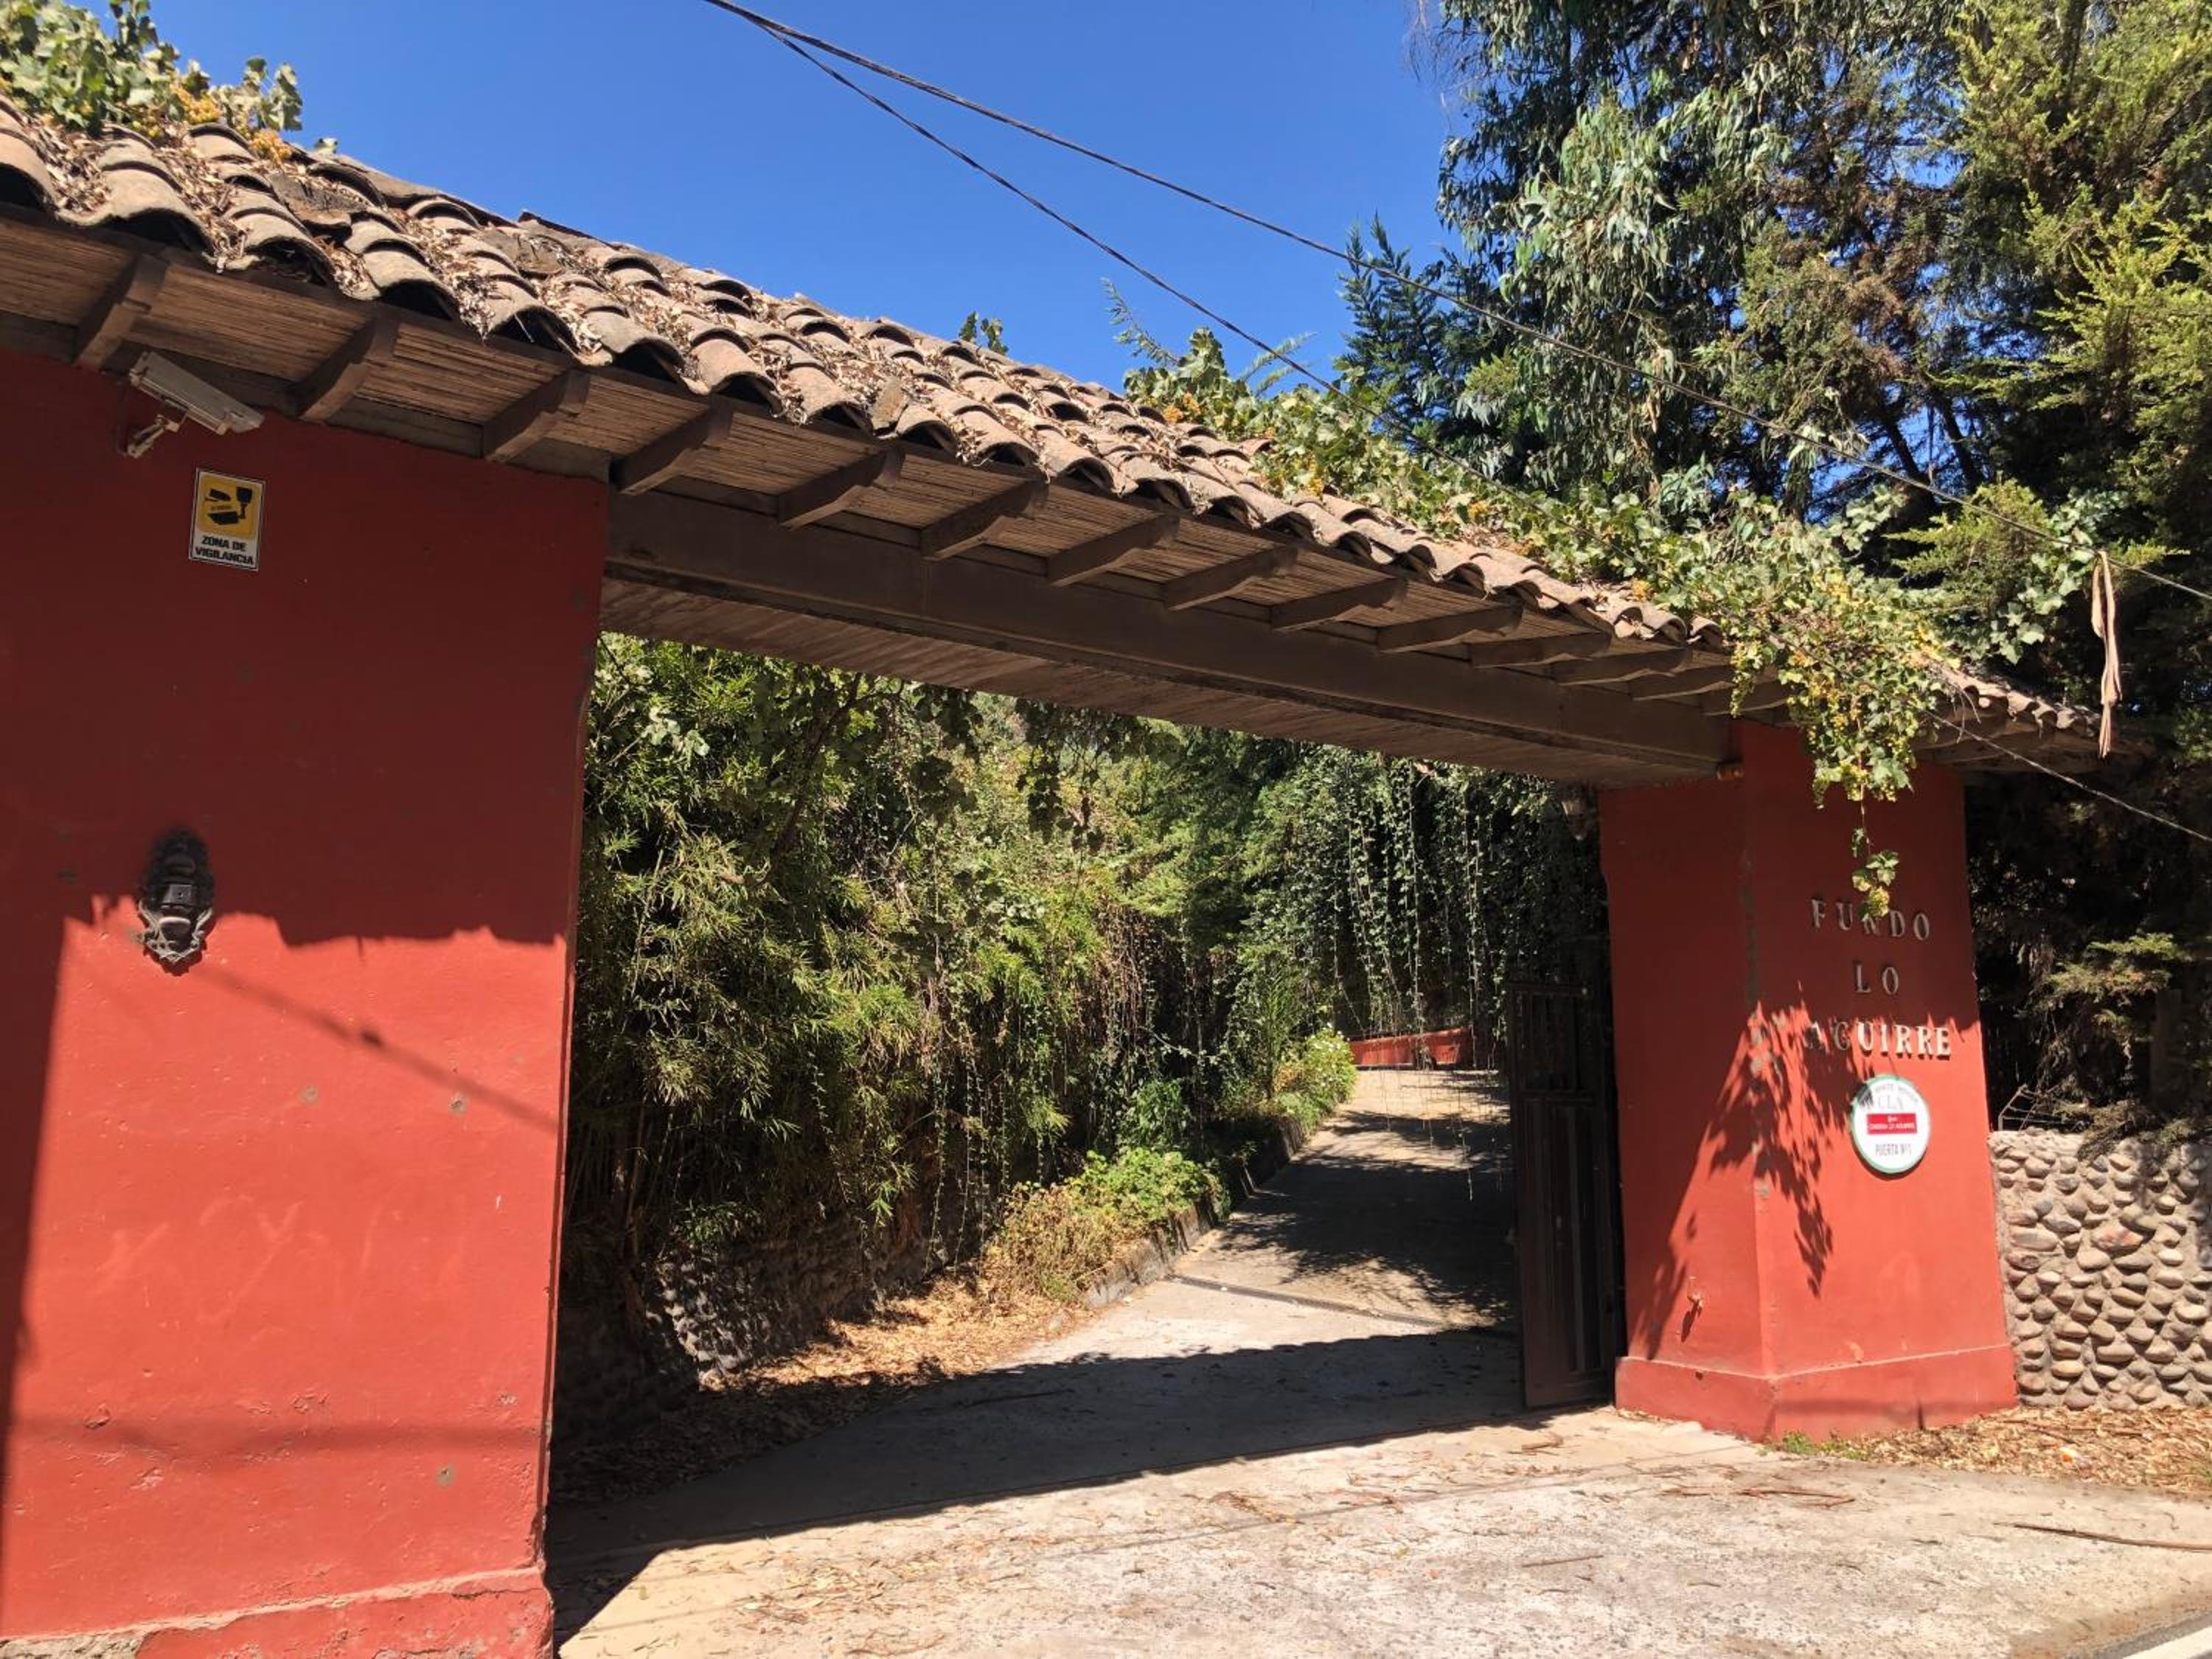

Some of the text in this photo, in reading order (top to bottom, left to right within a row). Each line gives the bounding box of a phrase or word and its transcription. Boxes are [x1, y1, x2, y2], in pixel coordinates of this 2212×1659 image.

[201, 535, 246, 552] ZONA DE
[195, 547, 254, 565] VIGILANCIA
[1855, 964, 1899, 995] LO
[1803, 1020, 1952, 1056] AGUIRRE
[1875, 1144, 1899, 1157] PUERTA
